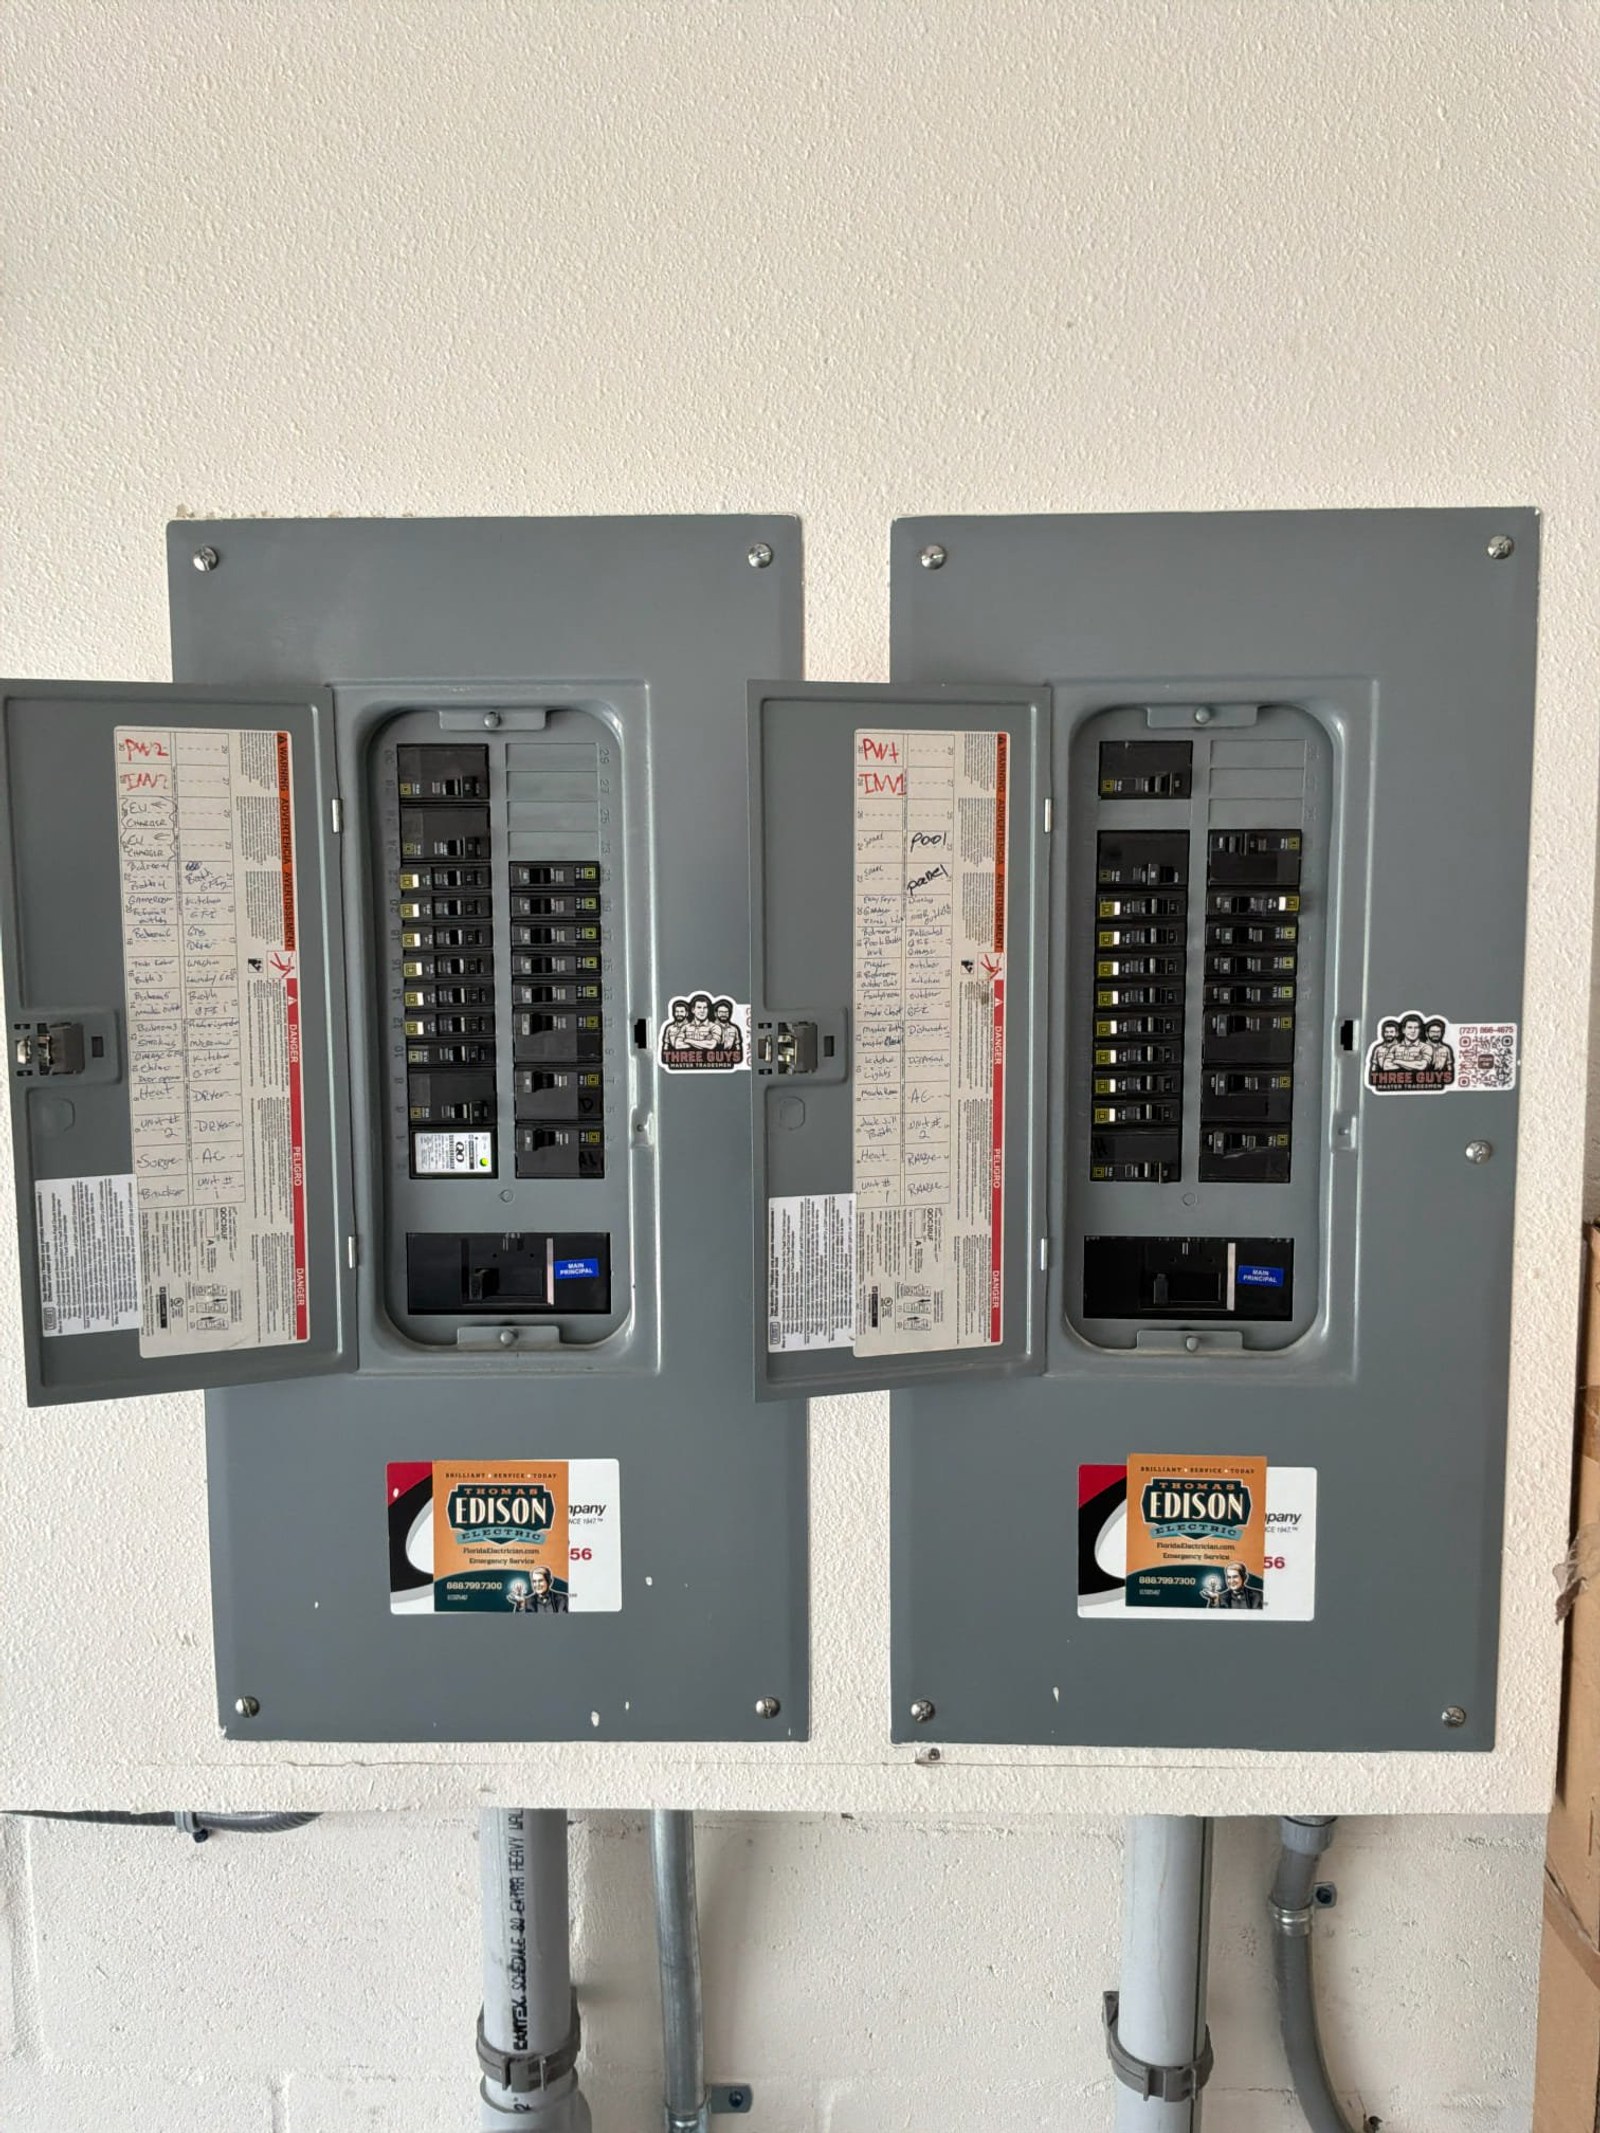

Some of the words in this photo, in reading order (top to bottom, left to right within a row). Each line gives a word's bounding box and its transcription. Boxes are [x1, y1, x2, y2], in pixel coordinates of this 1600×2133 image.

[277, 747, 289, 791] WARNING
[281, 798, 293, 866] ADVERTENCIA
[288, 1024, 299, 1063] DANGER
[663, 1051, 704, 1062] THREE
[706, 1051, 740, 1062] GUYS
[994, 1025, 1003, 1065] DANGER
[1372, 1073, 1413, 1084] THREE
[1416, 1072, 1453, 1083] GUYS
[292, 1146, 303, 1187] PELIGRO
[992, 1149, 1002, 1189] PELIGRO
[559, 1268, 593, 1276] PRINCIPAL
[1242, 1274, 1278, 1283] PRINCIPAL
[295, 1268, 305, 1306] DANGER
[991, 1270, 1000, 1309] DANGER
[1159, 1482, 1235, 1490] THOMAS
[455, 1497, 546, 1524] EDISON
[1150, 1491, 1243, 1520] EDISON
[1265, 1513, 1302, 1525] pany
[461, 1528, 541, 1540] ELECTRIC
[1155, 1523, 1238, 1537] ELECTRIC
[469, 1557, 507, 1566] Emergency
[509, 1557, 535, 1565] Service
[1163, 1552, 1202, 1561] Emergency
[1203, 1553, 1230, 1561] Service
[509, 1838, 525, 1876] HEAVY
